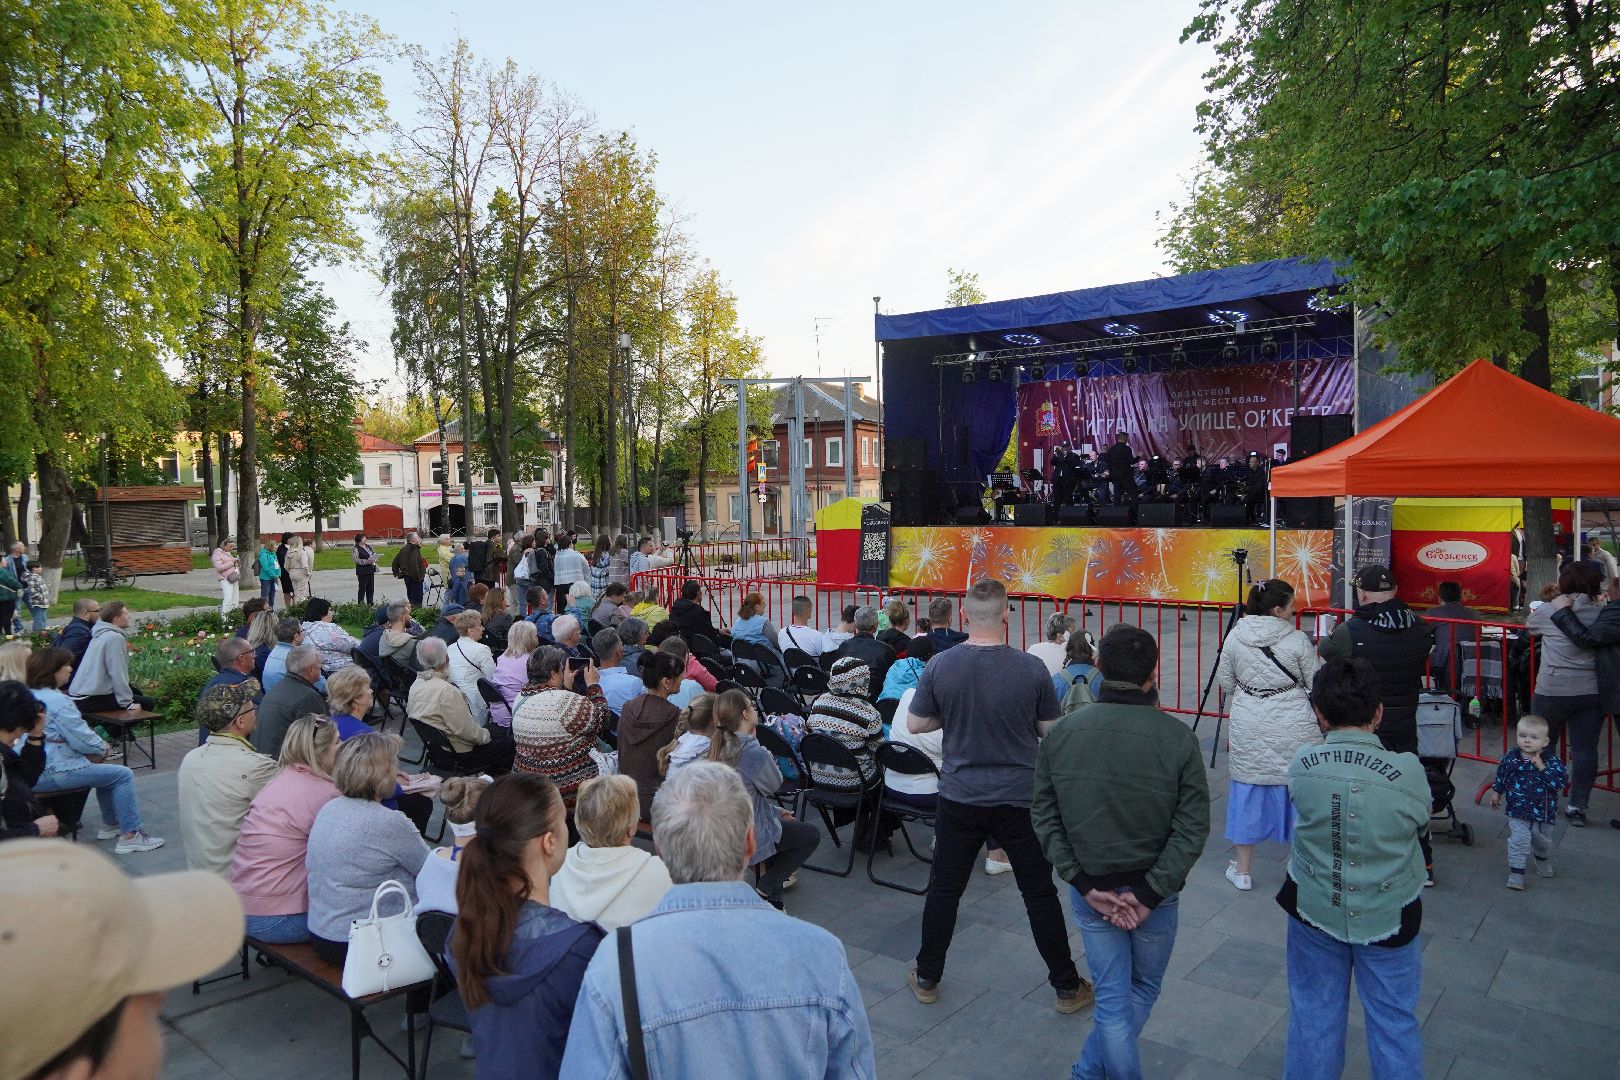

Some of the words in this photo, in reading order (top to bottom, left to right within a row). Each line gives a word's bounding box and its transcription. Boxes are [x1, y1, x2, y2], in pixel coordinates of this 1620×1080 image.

[1171, 386, 1232, 399] ОБЛАСТНОЙ
[1203, 394, 1267, 407] ФЕСТИВАЛЬ
[1179, 411, 1242, 431] УЛИЦЕ,
[1300, 750, 1403, 782] AUTHORIZED
